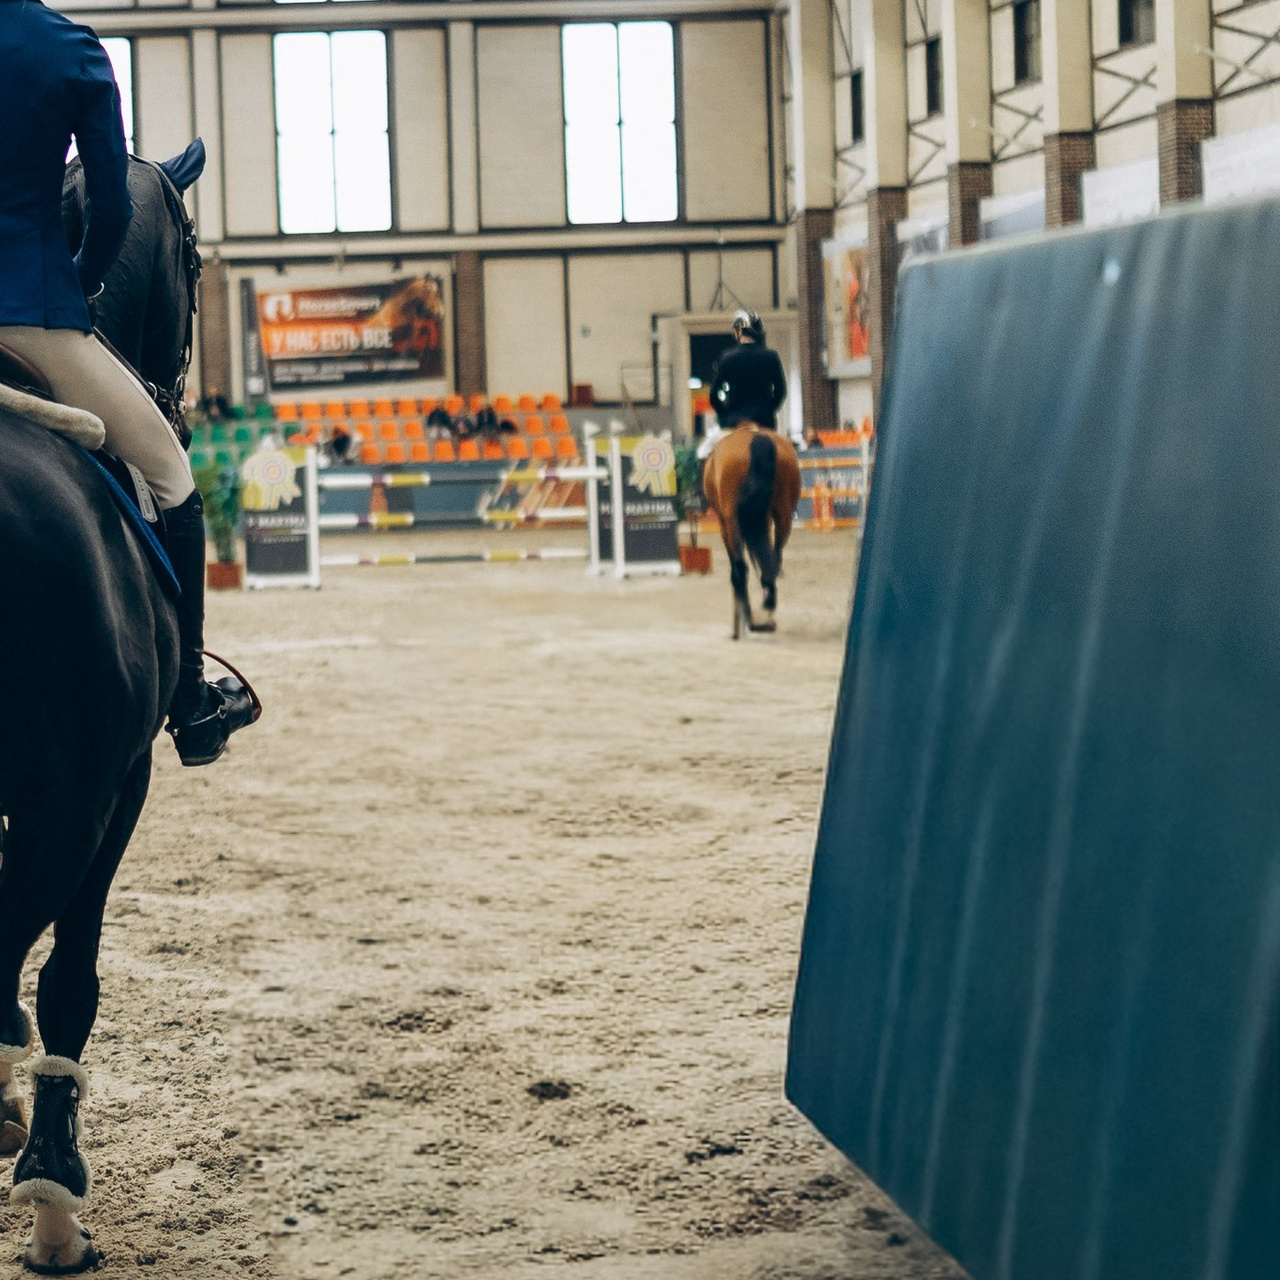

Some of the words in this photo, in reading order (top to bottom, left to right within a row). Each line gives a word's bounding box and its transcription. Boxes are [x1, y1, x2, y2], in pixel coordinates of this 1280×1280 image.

[271, 330, 283, 352] У
[286, 329, 318, 352] НАС
[321, 327, 360, 352] ЕСТЬ
[362, 326, 393, 350] ВСЕ
